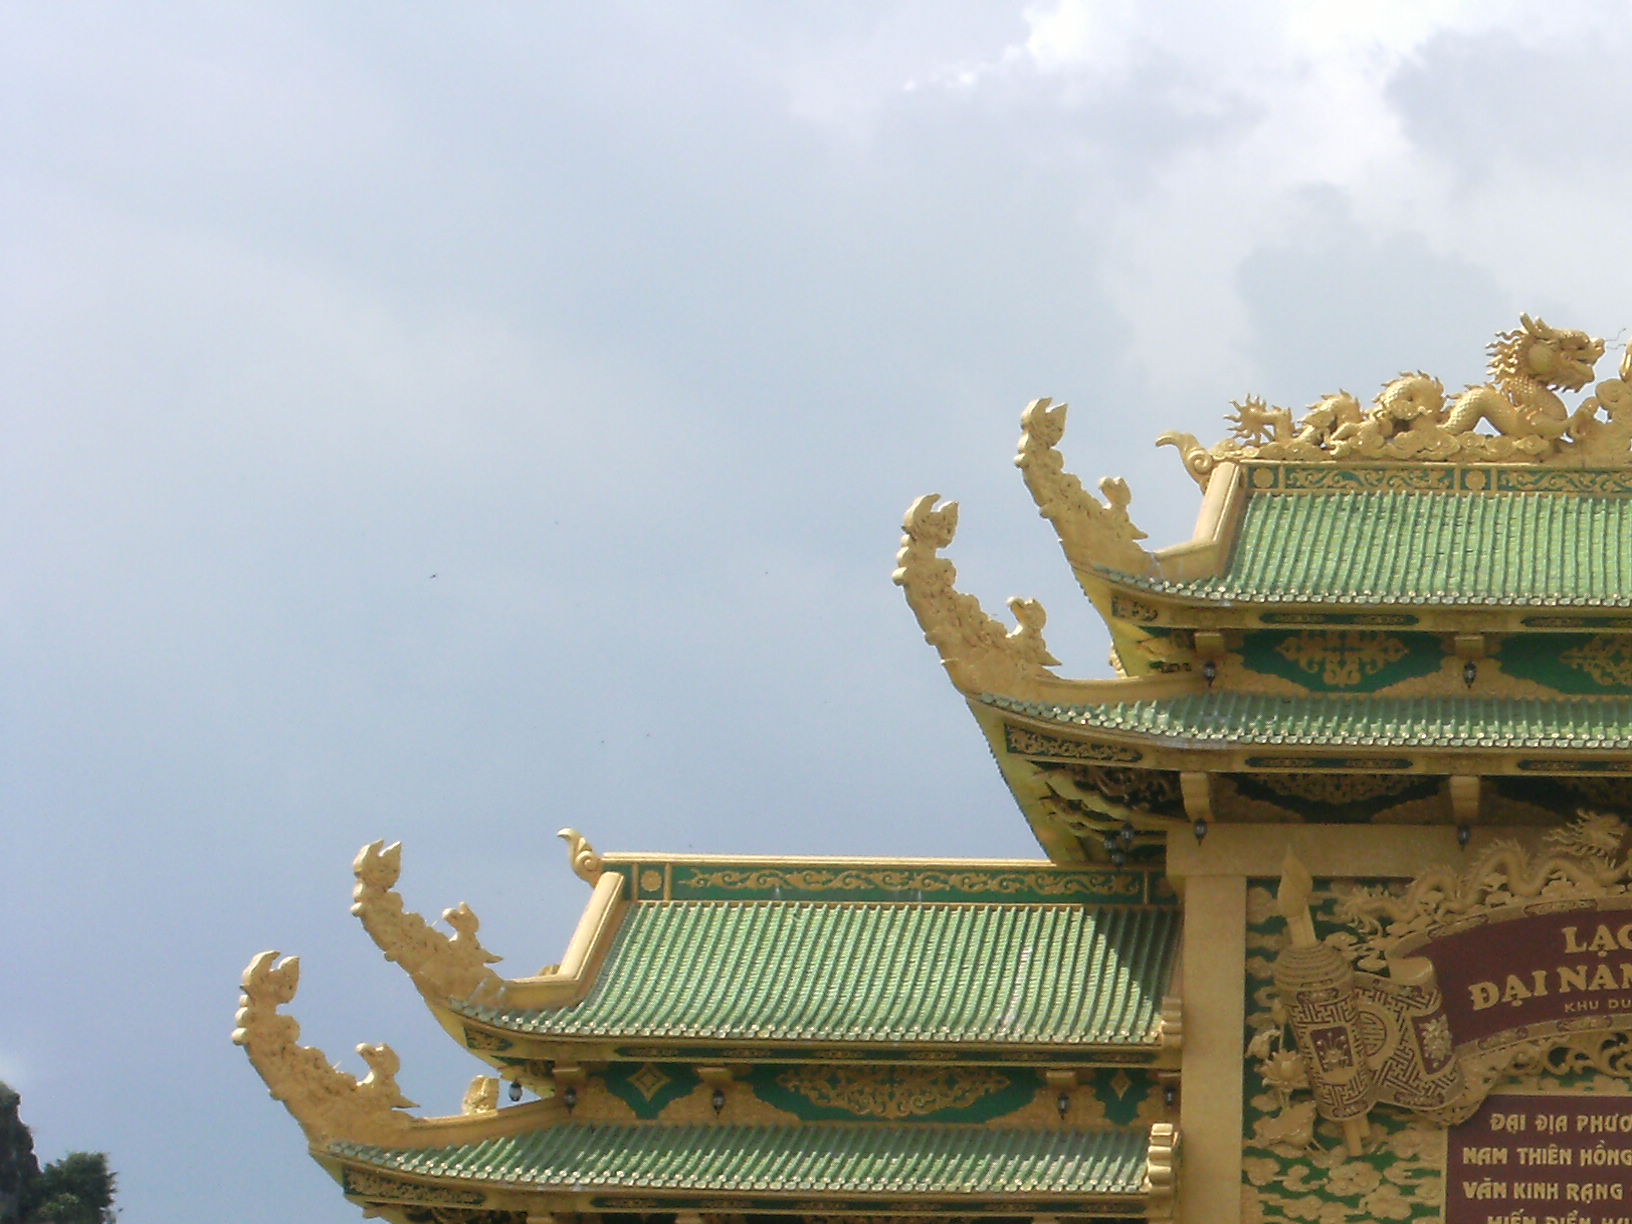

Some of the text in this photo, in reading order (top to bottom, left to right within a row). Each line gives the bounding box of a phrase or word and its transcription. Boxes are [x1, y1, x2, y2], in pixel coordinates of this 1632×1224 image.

[1468, 970, 1549, 1011] ĐẠI
[1564, 1000, 1599, 1013] KHU
[1607, 999, 1631, 1009] DU
[1490, 1113, 1526, 1134] ĐẠI
[1534, 1114, 1568, 1135] ĐỊA
[1462, 1147, 1508, 1167] NAM
[1516, 1143, 1572, 1166] THIÊN
[1579, 1139, 1632, 1167] HỒNG
[1462, 1177, 1507, 1200] VĂN
[1513, 1181, 1559, 1200] KINH
[1566, 1183, 1623, 1204] RẠNG
